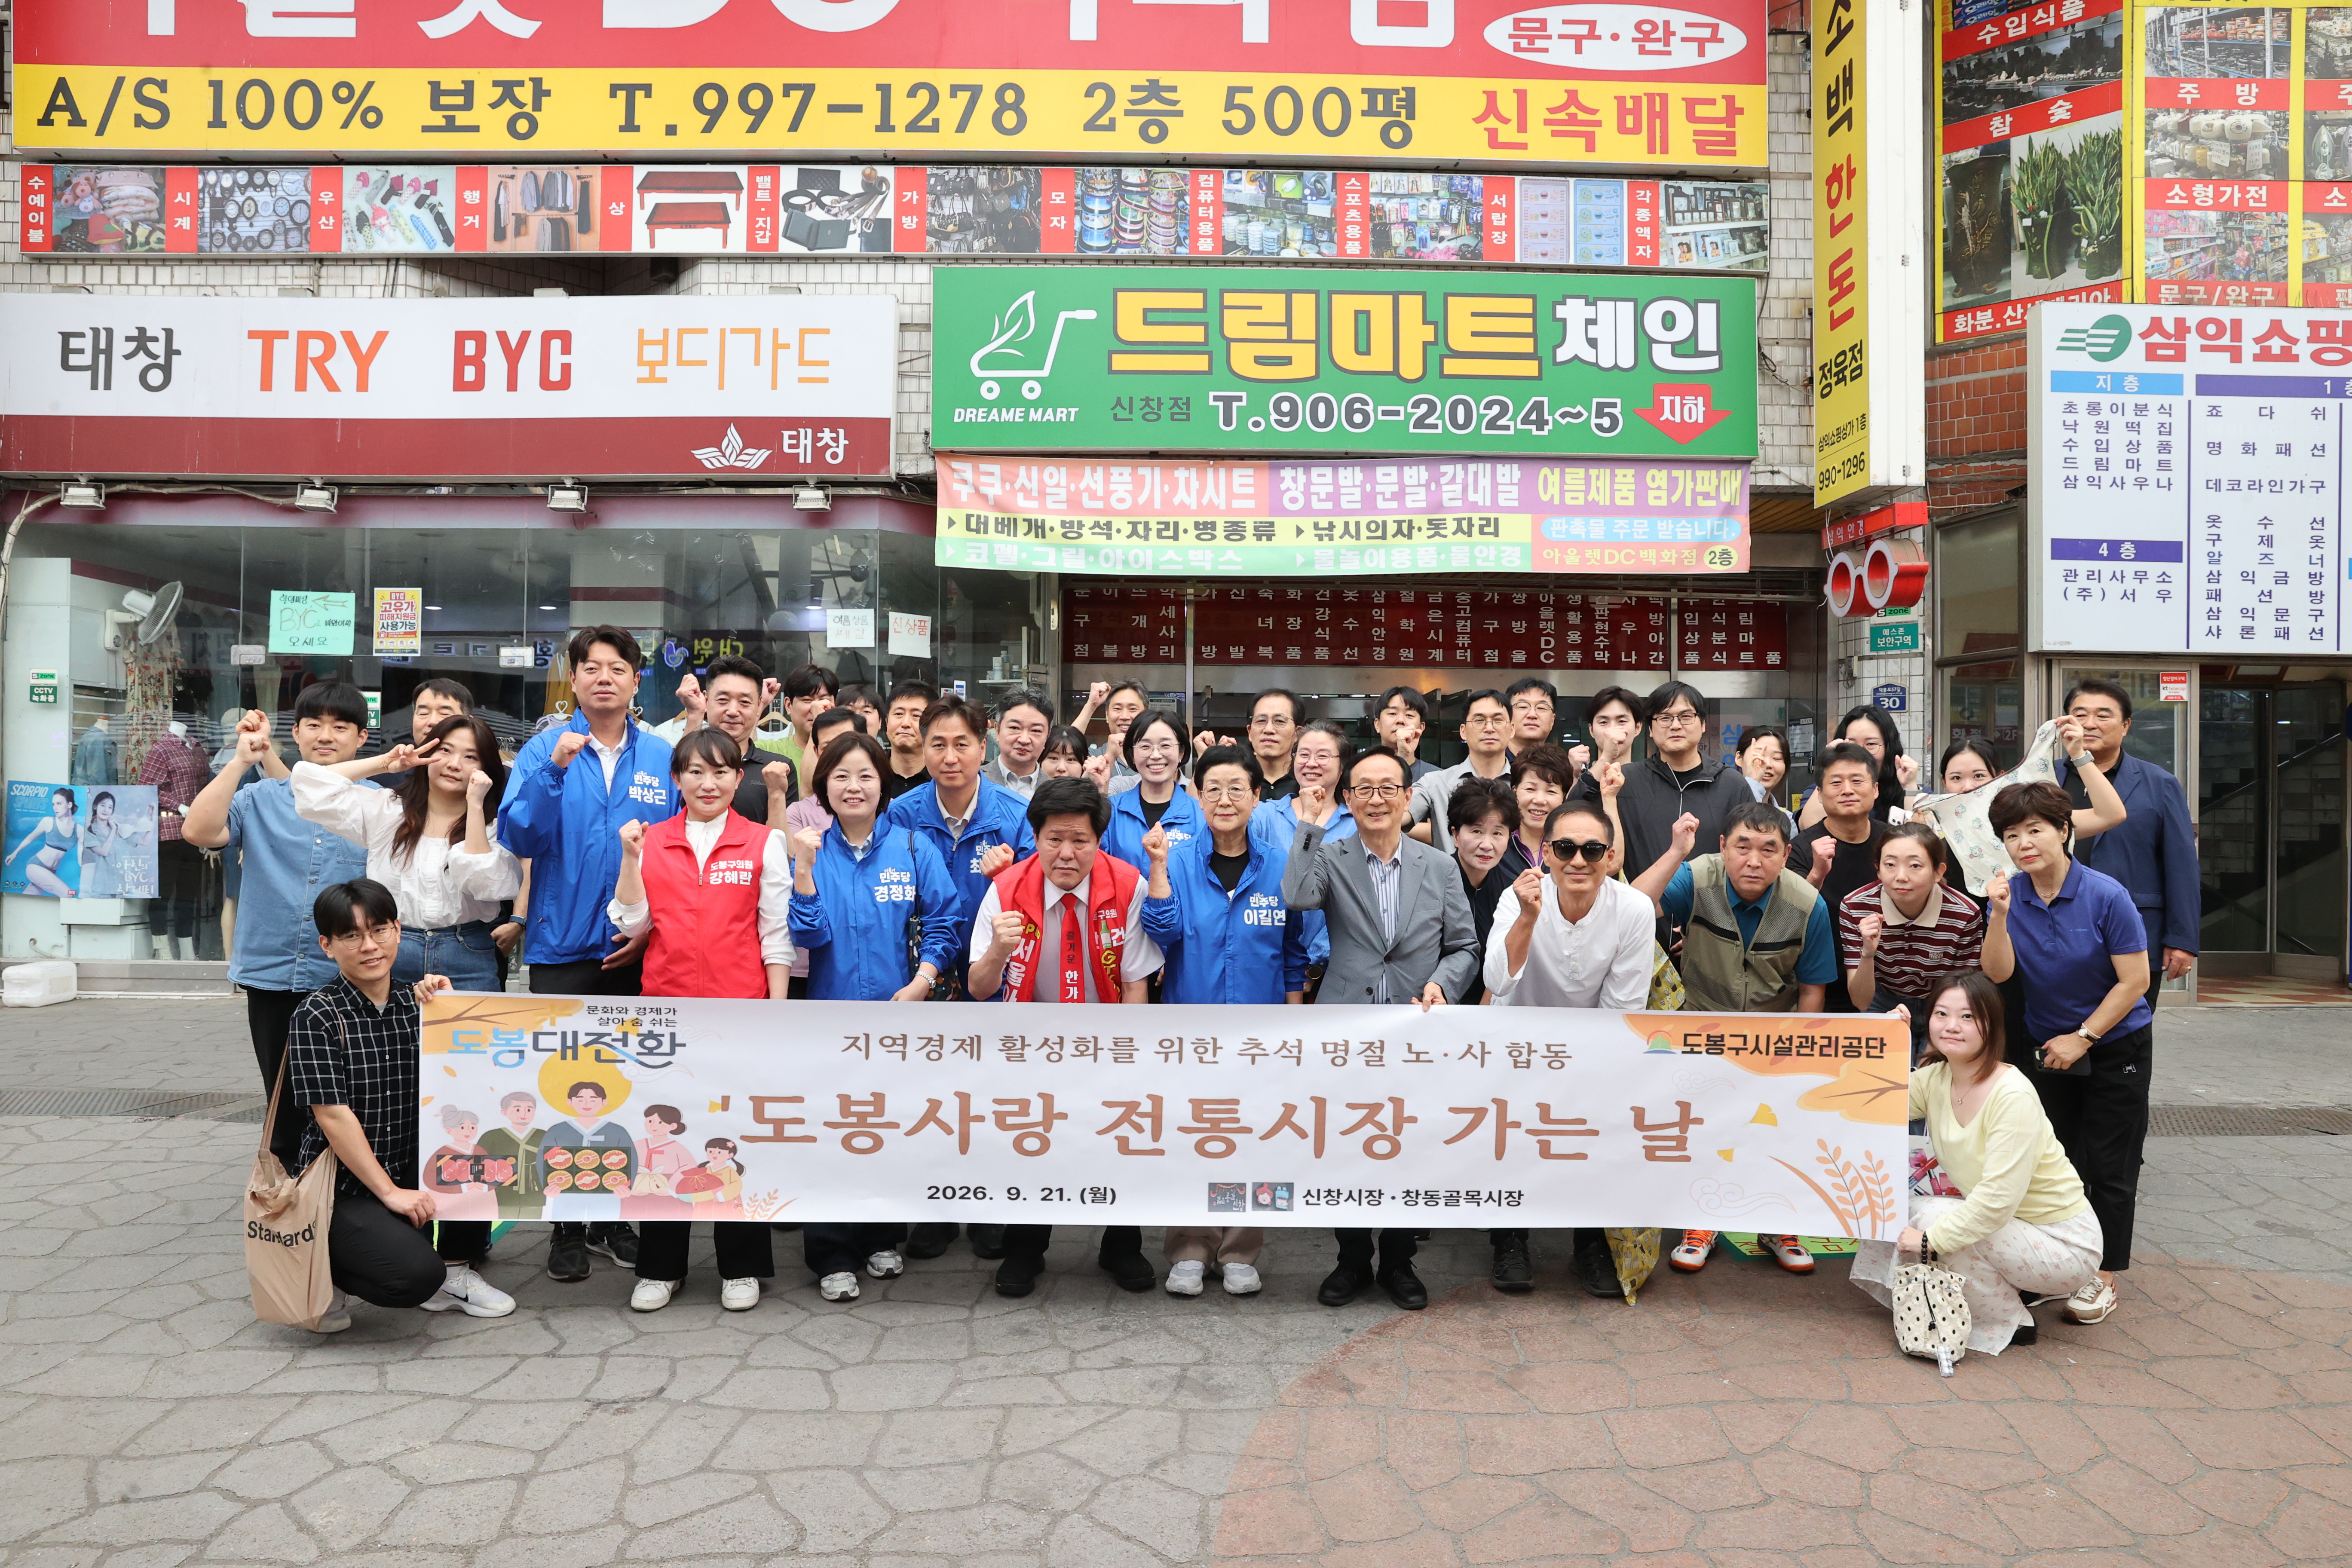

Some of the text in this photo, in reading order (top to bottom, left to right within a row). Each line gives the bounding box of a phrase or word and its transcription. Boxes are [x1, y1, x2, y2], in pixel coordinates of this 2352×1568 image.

[1977, 0, 2085, 44] 수입식품
[1508, 18, 1724, 58] 문구·완구
[37, 76, 170, 137] A/S
[208, 79, 383, 130] 100%
[421, 77, 551, 140] 보장
[1083, 79, 1183, 144] 2층
[1222, 86, 1416, 150] 500평
[1472, 89, 1744, 156] 신속배달
[2165, 185, 2267, 206] 소형가전
[27, 175, 46, 243] 수예이불
[175, 191, 190, 230] 시계
[318, 190, 335, 230] 우산
[463, 190, 480, 229] 행거
[609, 202, 625, 216] 상
[902, 190, 919, 230] 가방
[1050, 190, 1066, 230] 모자
[1198, 174, 1213, 253] 컴퓨터용품
[1345, 177, 1362, 254] 스포츠용품
[1491, 194, 1507, 246] 서랍장
[1635, 189, 1652, 259] 각종액자
[1108, 288, 1723, 384] 드림마트 체인
[2138, 316, 2352, 366] 삼익쇼핑
[58, 327, 830, 392] 태창 TRY BYC 보디가드
[1819, 339, 1863, 399] 정육점
[953, 407, 1079, 423] DREAME MART
[1111, 396, 1191, 422] 신창점
[1659, 396, 1705, 423] 지하
[2062, 402, 2173, 417] 초롱이분식
[781, 427, 848, 464] 태창
[1819, 413, 1866, 453] 삼익쇼핑상가 1층
[1819, 451, 1865, 491] 990-1296
[2062, 475, 2173, 492] 삼익사우나
[1538, 468, 1742, 507] 여름제품 염가판매
[2206, 478, 2326, 495] 데코라인가구
[1551, 518, 1736, 540] 판촉물 주문 받습니다.
[1828, 518, 1865, 545] 삼익안경
[1543, 548, 1733, 566] 아울렛DC백화점 2층
[2063, 569, 2173, 584] 관리사무소
[381, 601, 415, 612] 고유가
[380, 621, 416, 631] 사용가능
[892, 617, 928, 636] 신상품
[1877, 635, 1911, 647] 보안구역
[1880, 697, 1899, 708] 30
[10, 784, 49, 798] SCORPIO
[634, 774, 659, 787] 민주당
[629, 786, 666, 805] 박상근
[124, 872, 148, 882] BYC
[709, 870, 753, 886] 강혜란
[710, 860, 753, 871] 도봉구의원
[879, 872, 911, 883] 민주당
[874, 885, 916, 902] 경정화
[1250, 896, 1278, 907] 민주당
[1243, 909, 1286, 926] 이길연
[586, 1005, 677, 1017] 문화와 경제가
[597, 1017, 677, 1027] 살아 숨 쉬는
[448, 1028, 686, 1069] 도봉대전환
[841, 1033, 983, 1062] 지역경제
[997, 1034, 1140, 1063] 활성화를
[1154, 1036, 1223, 1065] 위한
[1236, 1037, 1303, 1067] 추석
[1322, 1038, 1386, 1068] 명절
[1507, 1041, 1573, 1070] 합동
[1681, 1033, 1886, 1059] 도봉구시설관리공단
[1096, 1093, 1418, 1161] 전통시장
[1443, 1097, 1600, 1161] 가는
[1630, 1100, 1704, 1163] 날
[927, 1185, 1116, 1205] 2026. 9. 21. (월)
